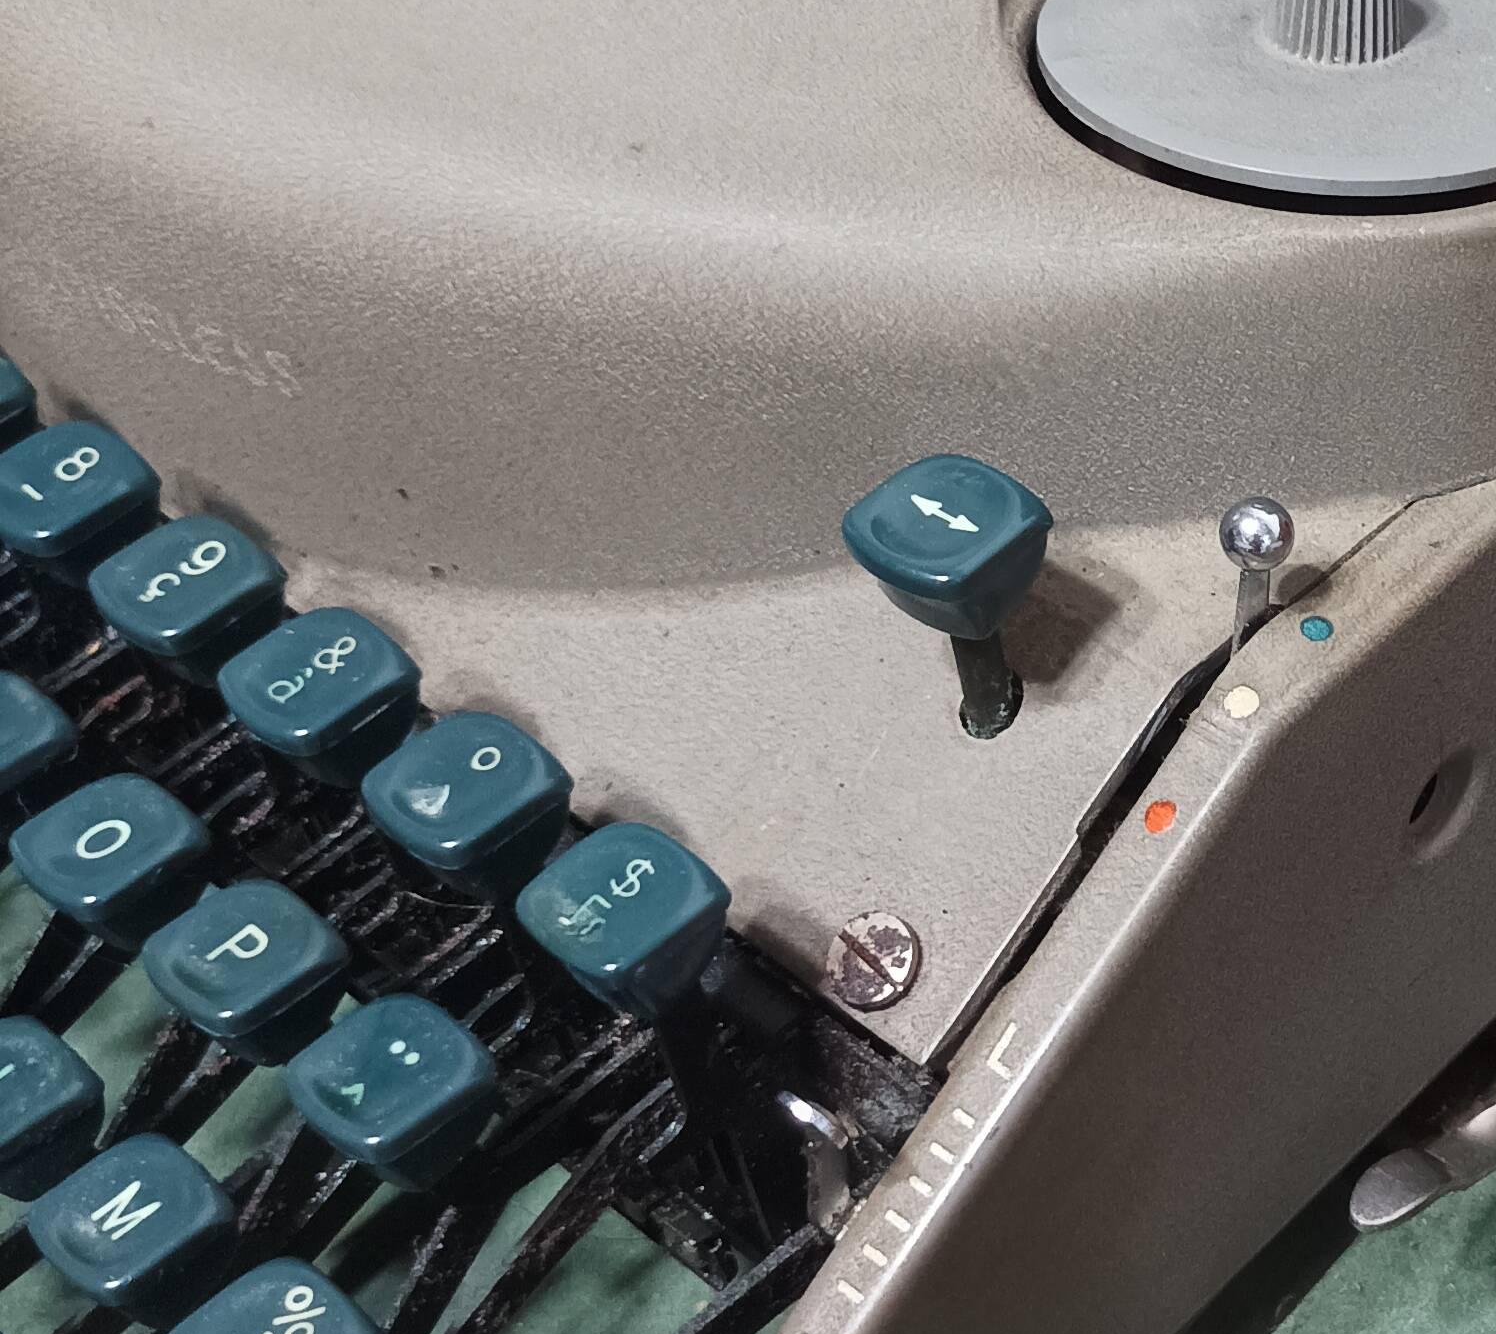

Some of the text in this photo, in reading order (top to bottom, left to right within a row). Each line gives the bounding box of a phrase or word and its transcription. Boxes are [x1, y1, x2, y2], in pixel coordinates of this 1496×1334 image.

[54, 446, 100, 481] 8
[179, 540, 227, 576] 9
[314, 636, 357, 674] &
[609, 858, 655, 898] $
[206, 923, 269, 961] P
[987, 1022, 1017, 1080] L
[91, 1180, 161, 1240] M
